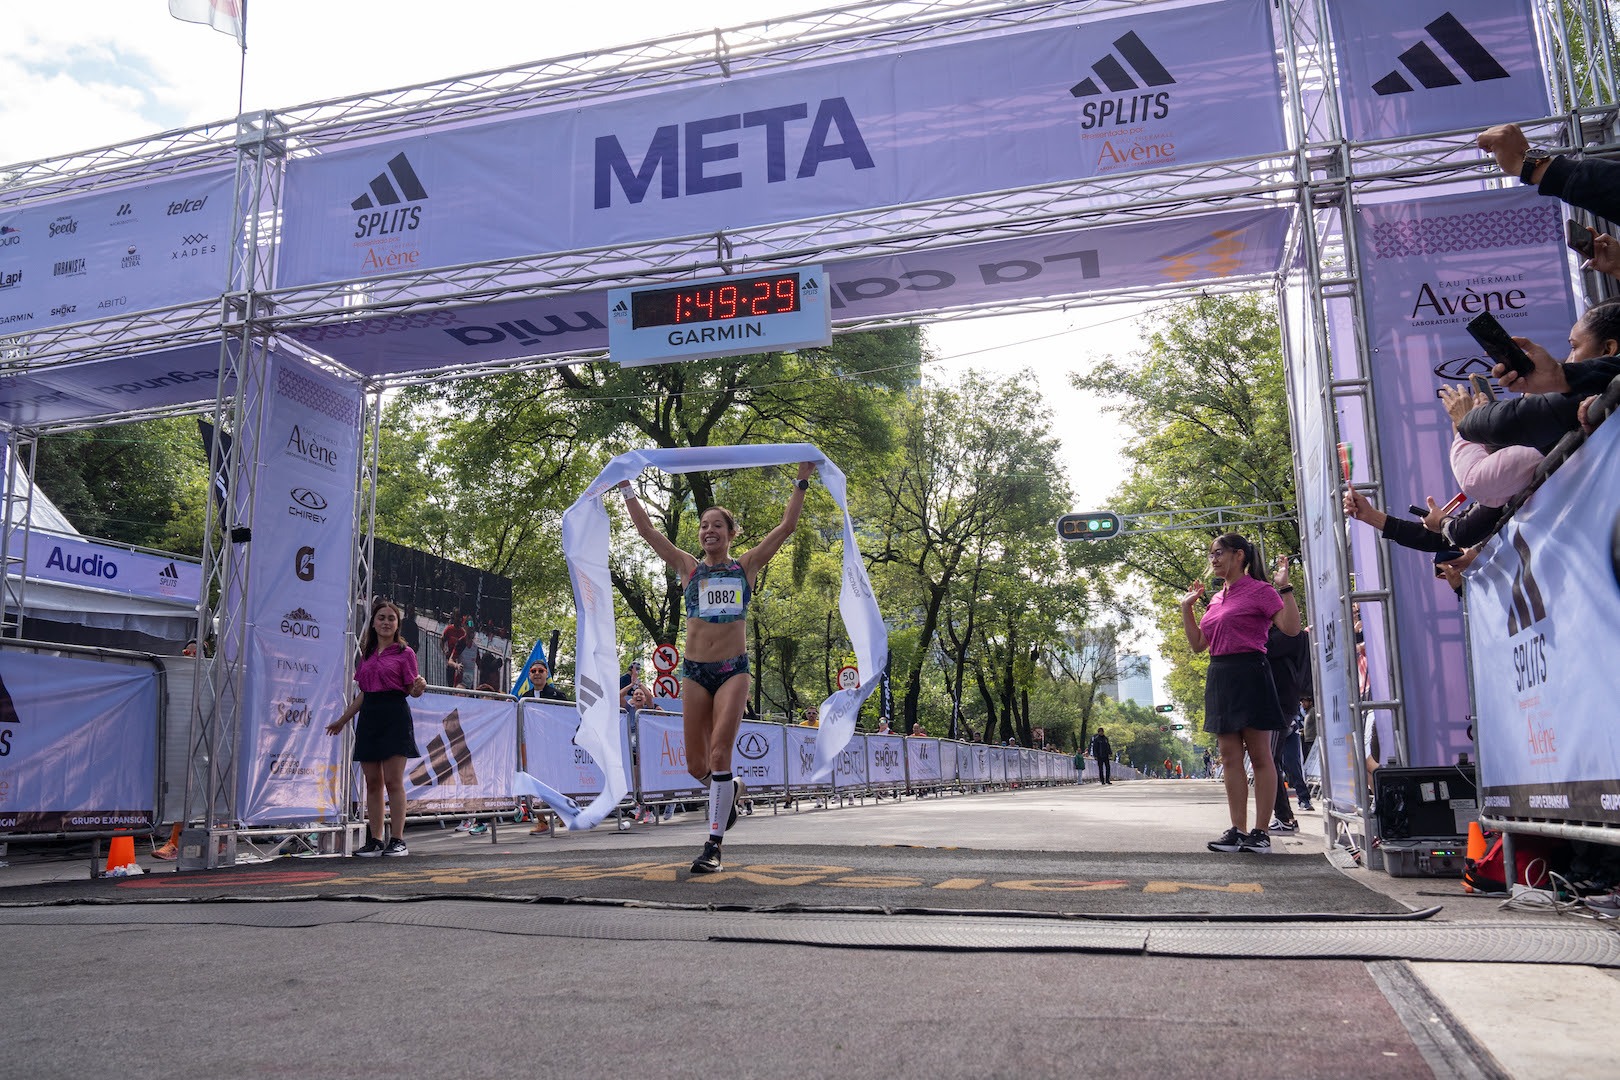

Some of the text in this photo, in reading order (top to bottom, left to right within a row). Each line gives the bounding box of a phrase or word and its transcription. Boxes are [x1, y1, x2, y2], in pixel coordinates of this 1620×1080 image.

[1081, 91, 1170, 130] SPLITS
[594, 96, 876, 210] META
[1097, 140, 1176, 166] Avène
[167, 195, 208, 216] telcel
[49, 219, 78, 238] Seeds
[354, 205, 422, 239] SPLITS
[121, 254, 141, 263] AMSTEL
[171, 244, 216, 260] XADES
[361, 247, 420, 270] Avène
[53, 257, 87, 277] URBANISTA
[121, 260, 141, 269] ULTRA
[1439, 273, 1525, 289] EAU THERMALE
[802, 288, 818, 296] SPLITS
[1411, 282, 1526, 319] Avène
[50, 305, 77, 316] SHOKZ
[1412, 317, 1460, 327] LABORATOIRE
[668, 321, 763, 346] GARMIN
[286, 424, 338, 467] Avène
[288, 505, 328, 525] CHIREY
[45, 546, 118, 579] Audio
[159, 577, 178, 588] SPLITS
[707, 589, 736, 605] 0882
[277, 659, 319, 675] FINAMEX
[1513, 632, 1548, 693] SPLITS
[842, 671, 856, 682] 50
[277, 702, 314, 728] Seeds
[874, 751, 900, 767] SHOKZ
[736, 765, 771, 778] CHIREY
[71, 815, 148, 825] GRUPO EXPANSION
